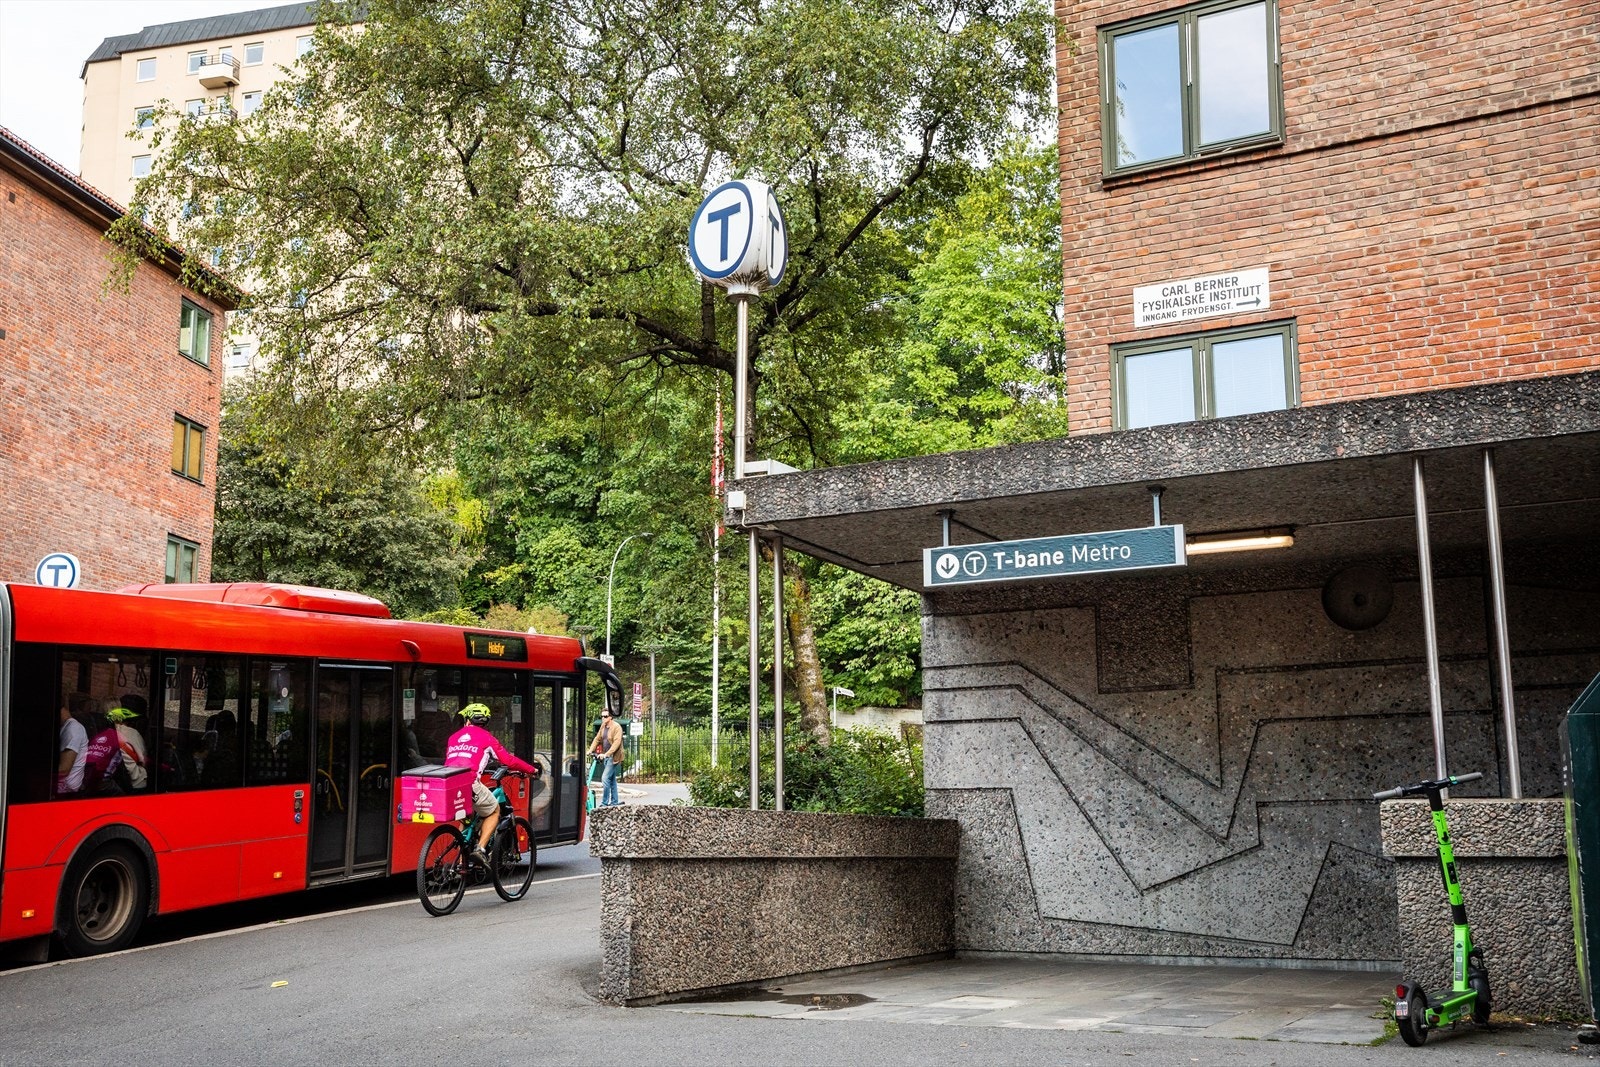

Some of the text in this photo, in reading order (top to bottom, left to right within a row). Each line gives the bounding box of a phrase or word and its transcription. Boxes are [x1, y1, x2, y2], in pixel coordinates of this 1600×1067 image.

[707, 202, 741, 262] T
[769, 207, 779, 269] T
[1142, 284, 1261, 312] FYSIKALSKE INSTITUTT
[1161, 276, 1239, 298] CARL BERNER
[1142, 302, 1234, 322] INNGANG FRYDENSGT.
[969, 544, 1131, 573] T T-bane Metro
[47, 564, 67, 587] T
